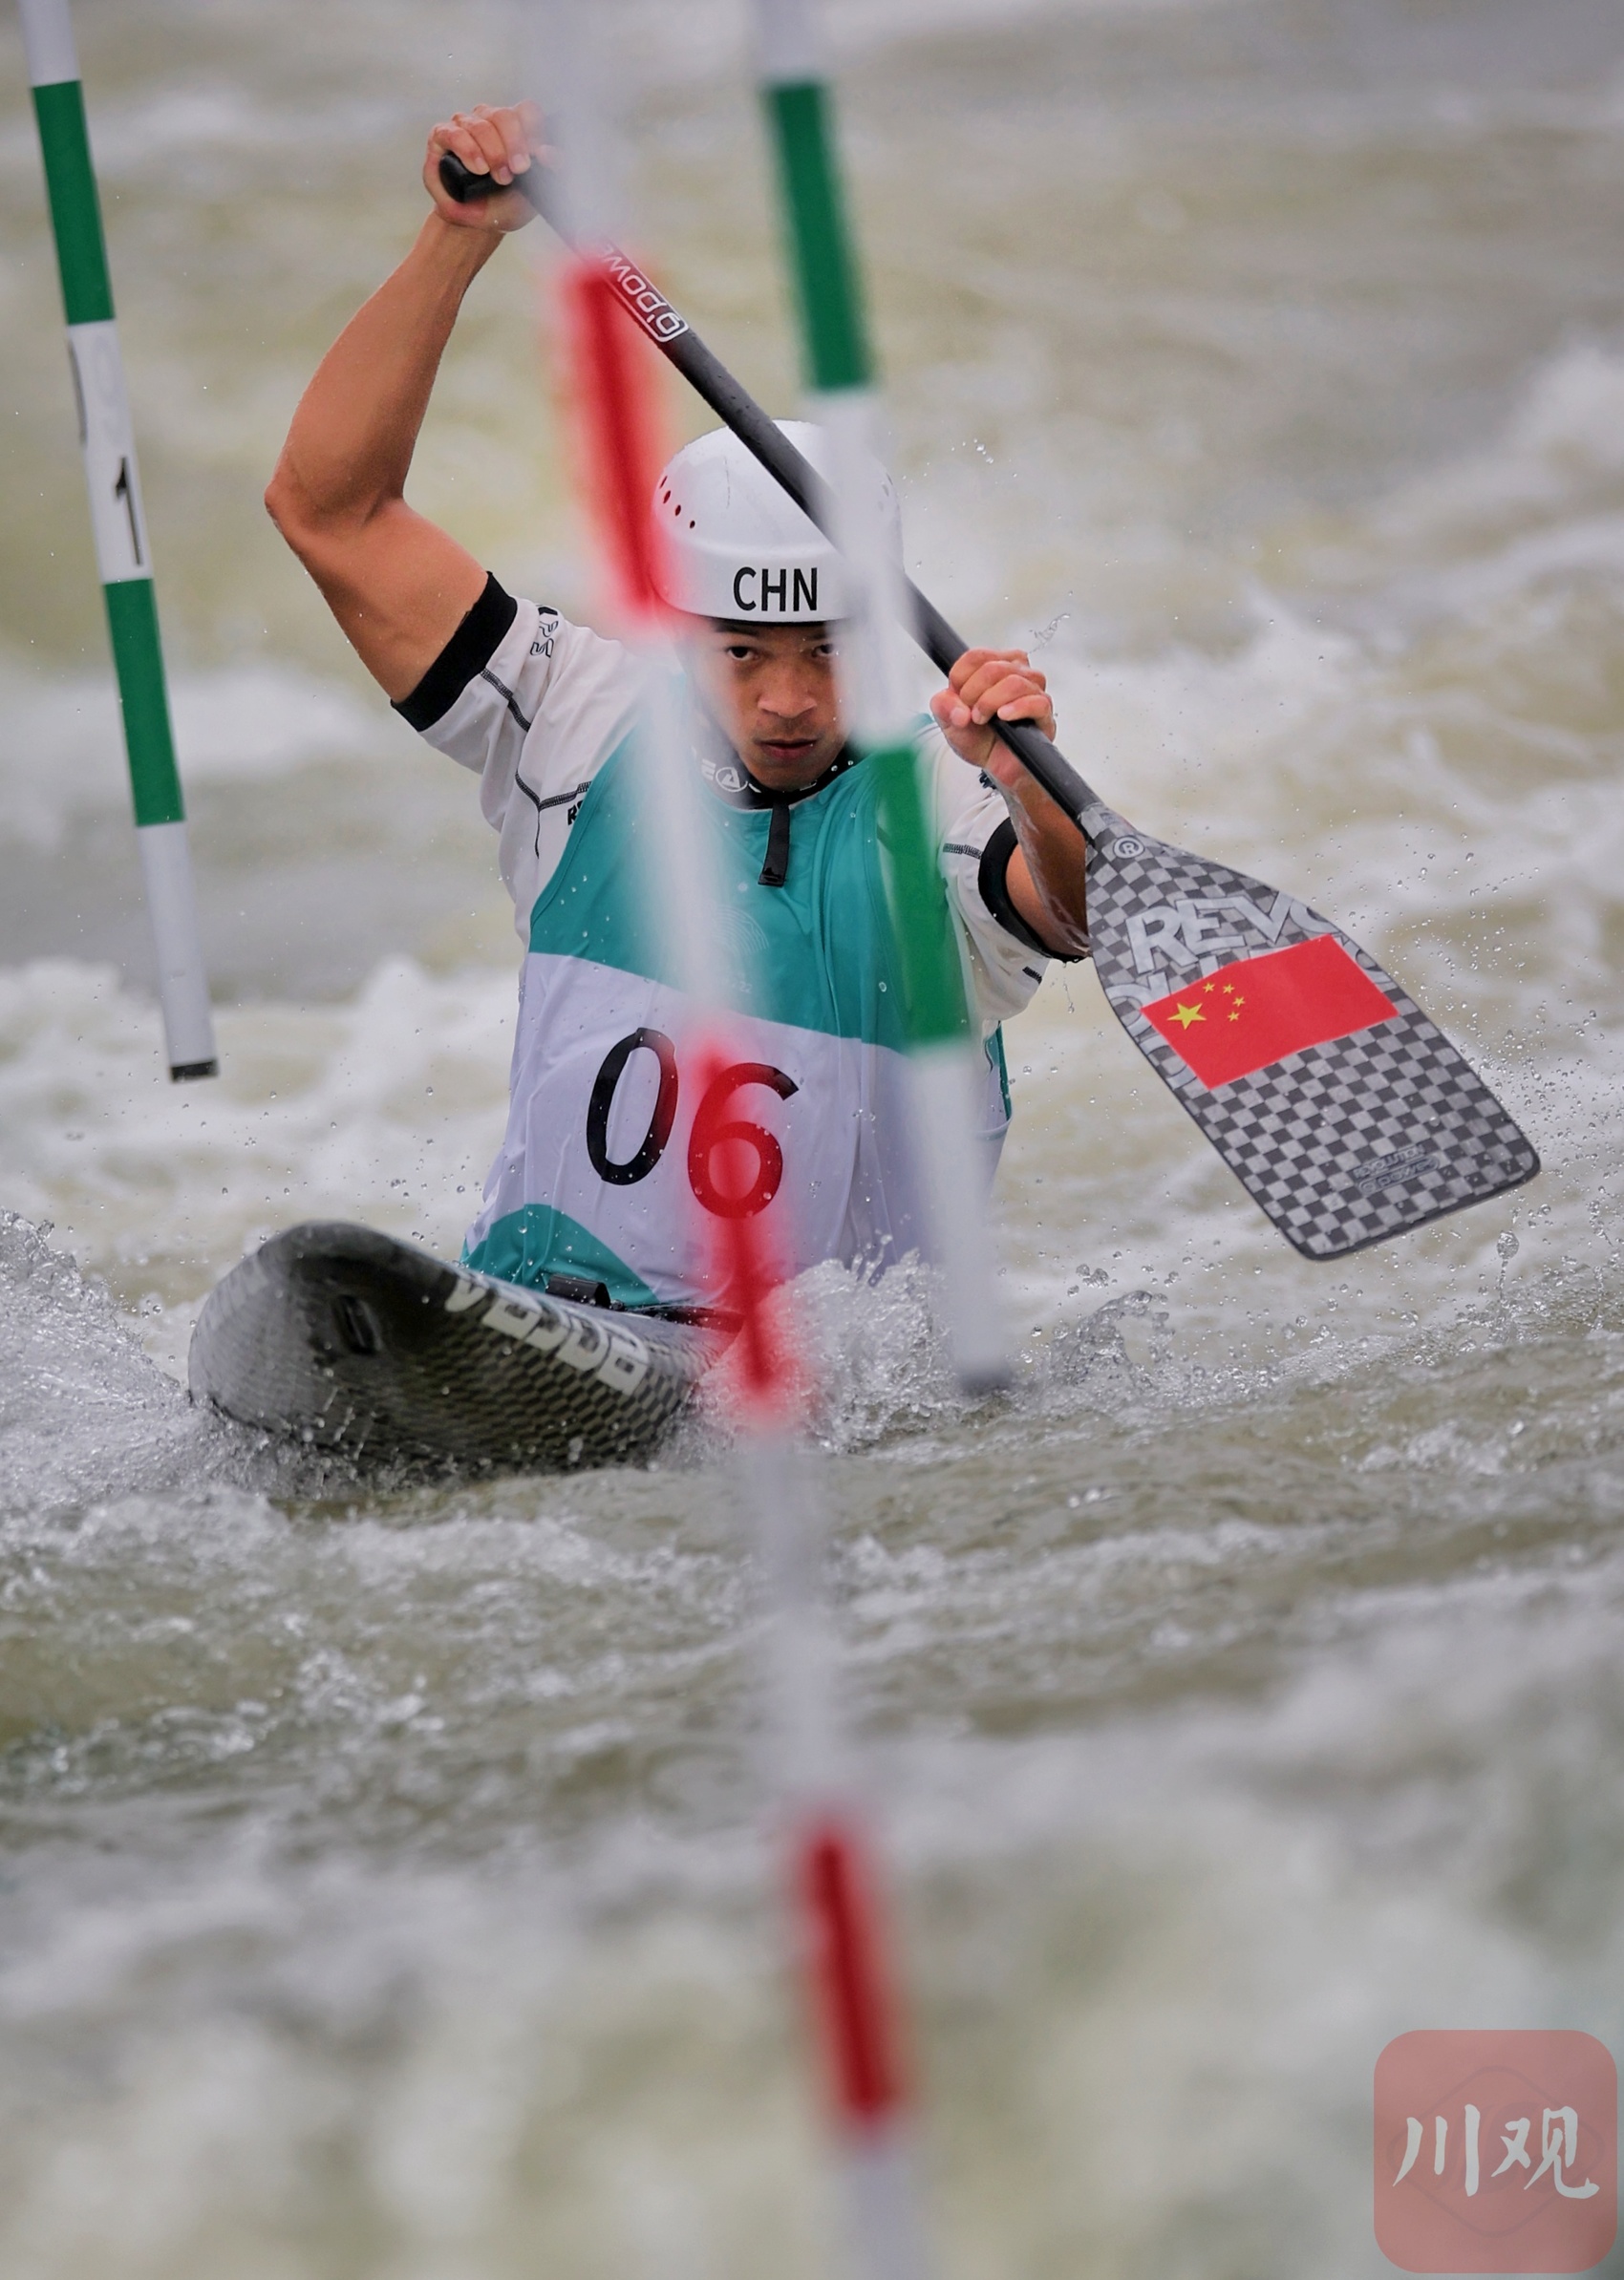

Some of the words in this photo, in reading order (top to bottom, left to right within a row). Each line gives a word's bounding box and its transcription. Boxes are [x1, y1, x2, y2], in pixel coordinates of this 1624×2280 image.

[114, 455, 143, 566] 1
[733, 565, 819, 612] CHN
[586, 1026, 800, 1220] 06
[1353, 1143, 1426, 1180] REVOLUTION
